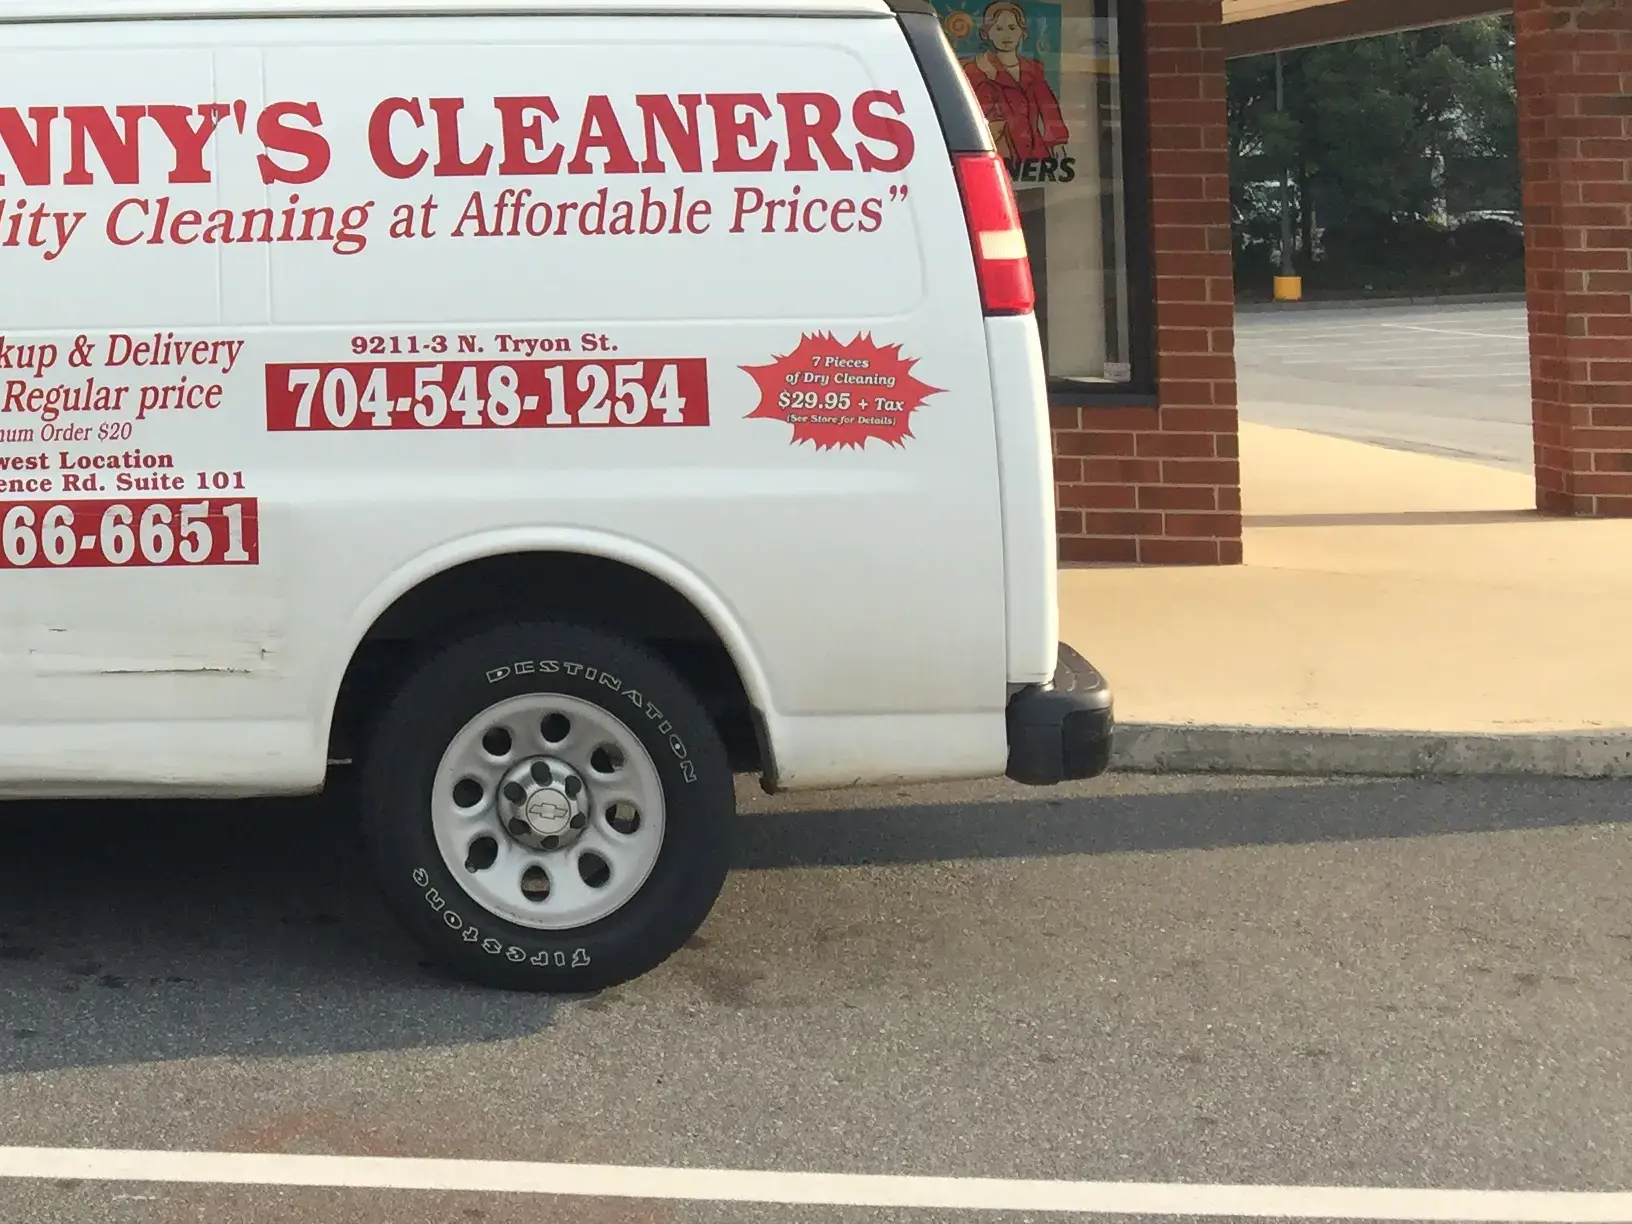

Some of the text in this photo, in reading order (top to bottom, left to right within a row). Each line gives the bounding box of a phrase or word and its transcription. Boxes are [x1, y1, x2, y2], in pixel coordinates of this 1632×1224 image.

[368, 89, 915, 177] CLEANERS
[106, 193, 375, 255] Cleaning
[389, 195, 435, 239] at
[451, 186, 712, 238] Affordable
[68, 334, 96, 368] &
[105, 332, 245, 374] Delivery
[351, 332, 619, 356] 9211-3 N. Tryon St.
[812, 355, 869, 369] 7 Pieces
[785, 372, 896, 388] of Dry Cleaning
[1, 378, 129, 422] Regular
[135, 376, 224, 420] price
[286, 362, 687, 429] 704-548-1254
[778, 388, 905, 412] $29.95 + Tax
[40, 422, 93, 443] Order
[97, 421, 134, 443] $20
[811, 414, 837, 425] Store
[837, 414, 855, 426] for
[857, 415, 897, 427] Details)
[59, 449, 175, 470] Location
[62, 473, 106, 492] Rd.
[116, 471, 186, 492] Suite
[197, 470, 246, 490] 101
[485, 659, 698, 785] DESTINATION
